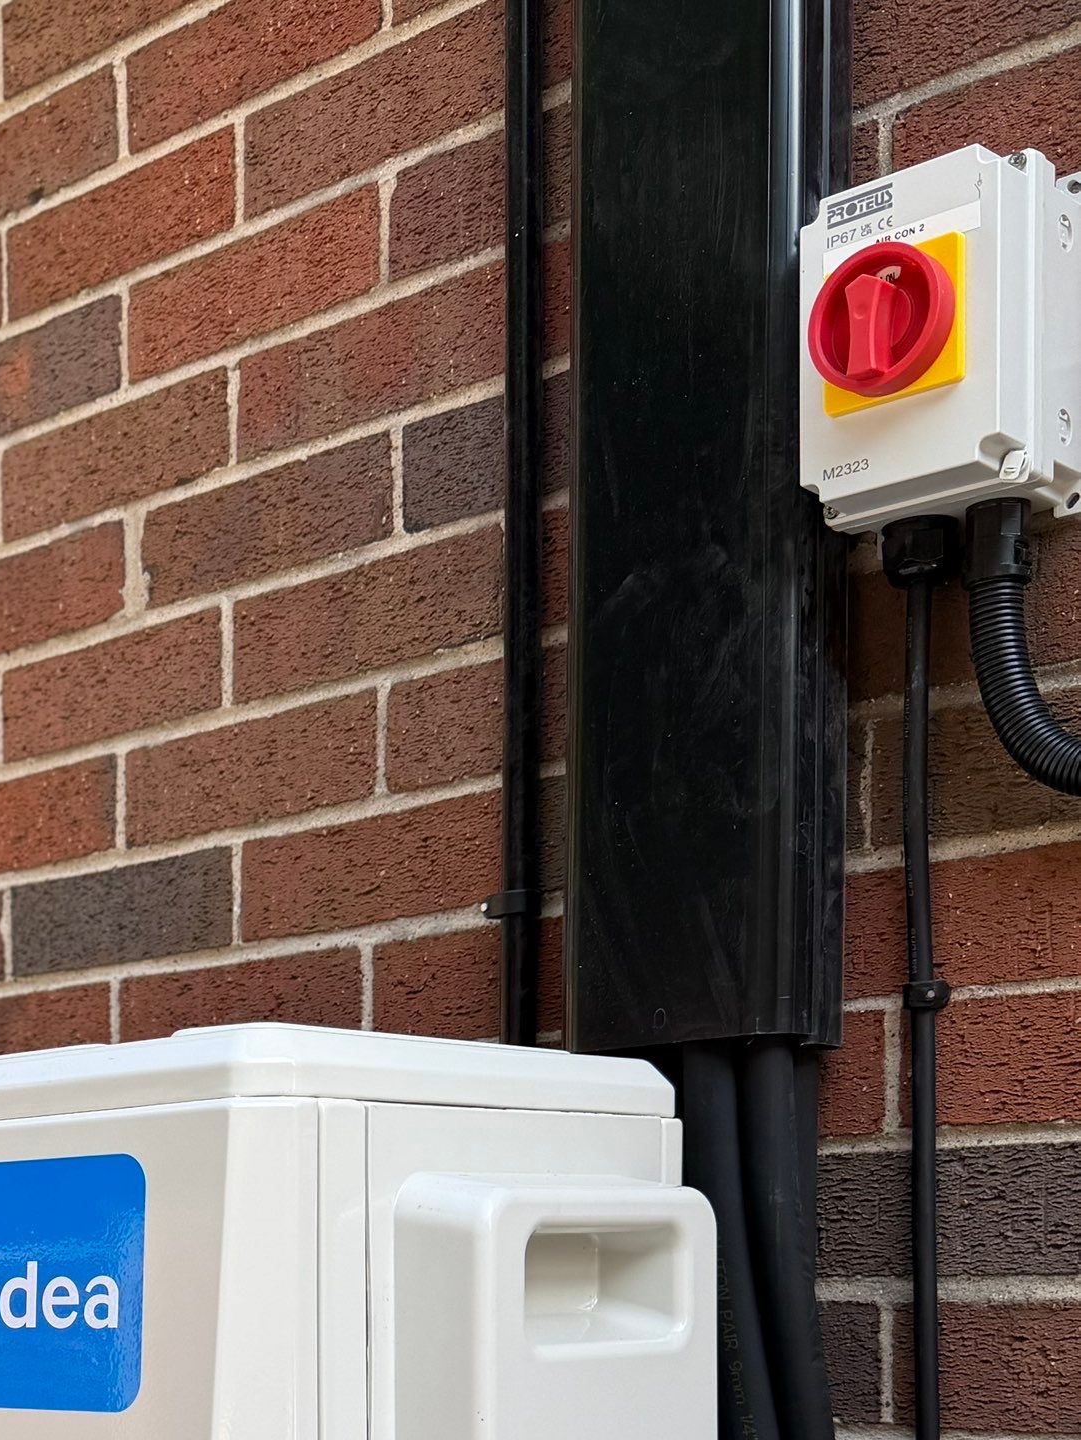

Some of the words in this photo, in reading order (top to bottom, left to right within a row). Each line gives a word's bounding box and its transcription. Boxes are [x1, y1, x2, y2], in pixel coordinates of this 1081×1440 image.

[827, 189, 893, 224] PROTEUS
[826, 229, 857, 249] IP67
[894, 227, 916, 240] CON
[919, 223, 925, 232] 2
[822, 458, 869, 481] M2323
[719, 1309, 738, 1352] PAIR
[728, 1360, 746, 1407] 9mm
